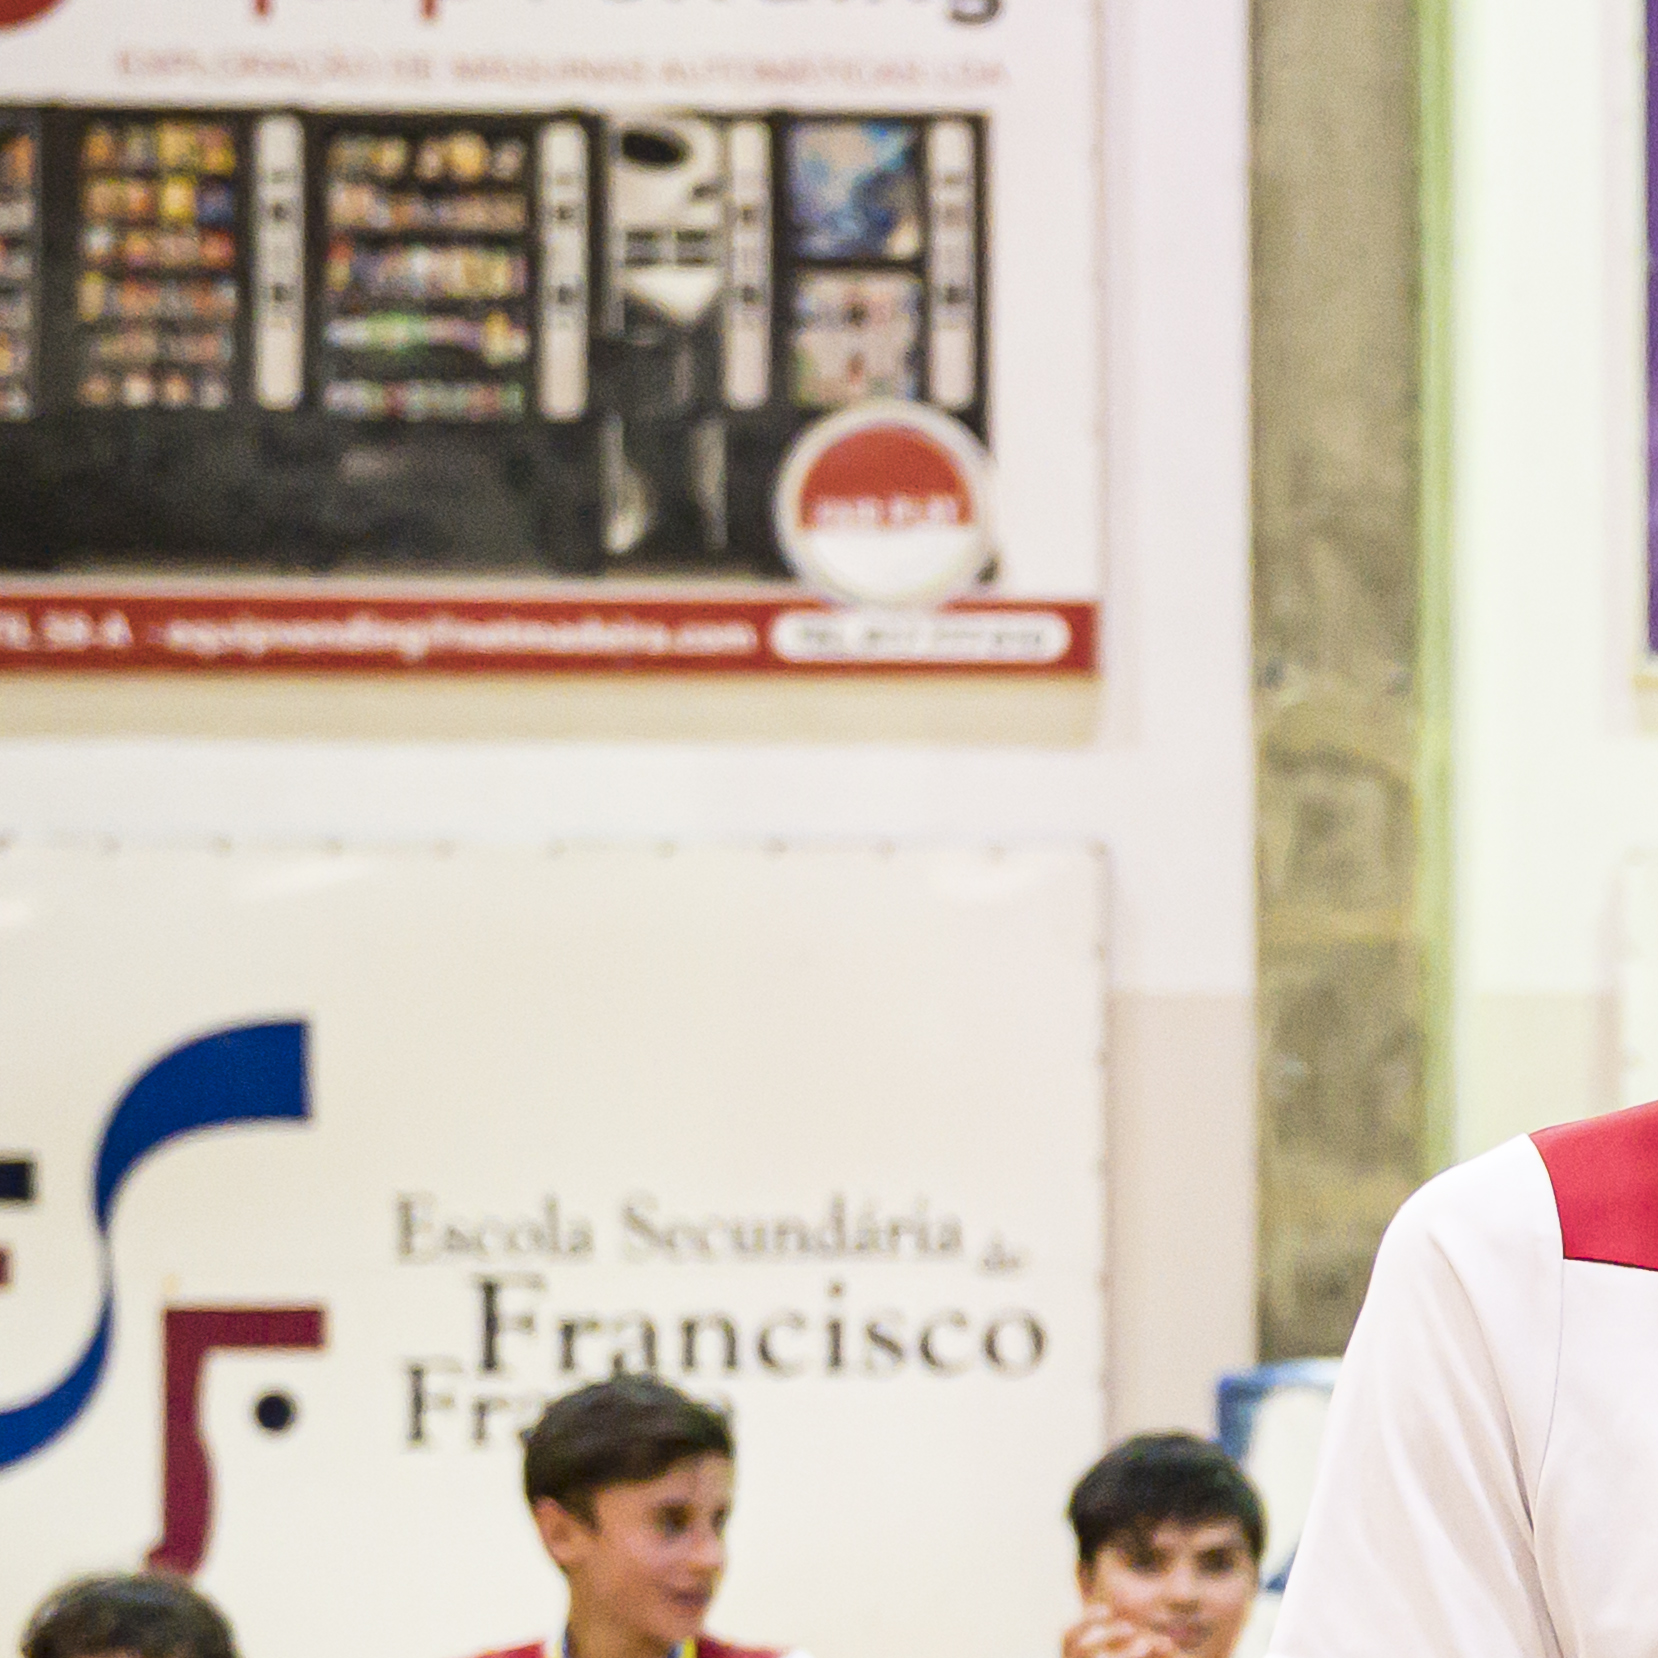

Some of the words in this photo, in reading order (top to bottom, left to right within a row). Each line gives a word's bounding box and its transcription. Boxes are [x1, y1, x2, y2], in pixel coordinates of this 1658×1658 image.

[396, 1190, 594, 1263] Escola
[620, 1186, 966, 1262] Secundária
[476, 1270, 1050, 1379] Francisco
